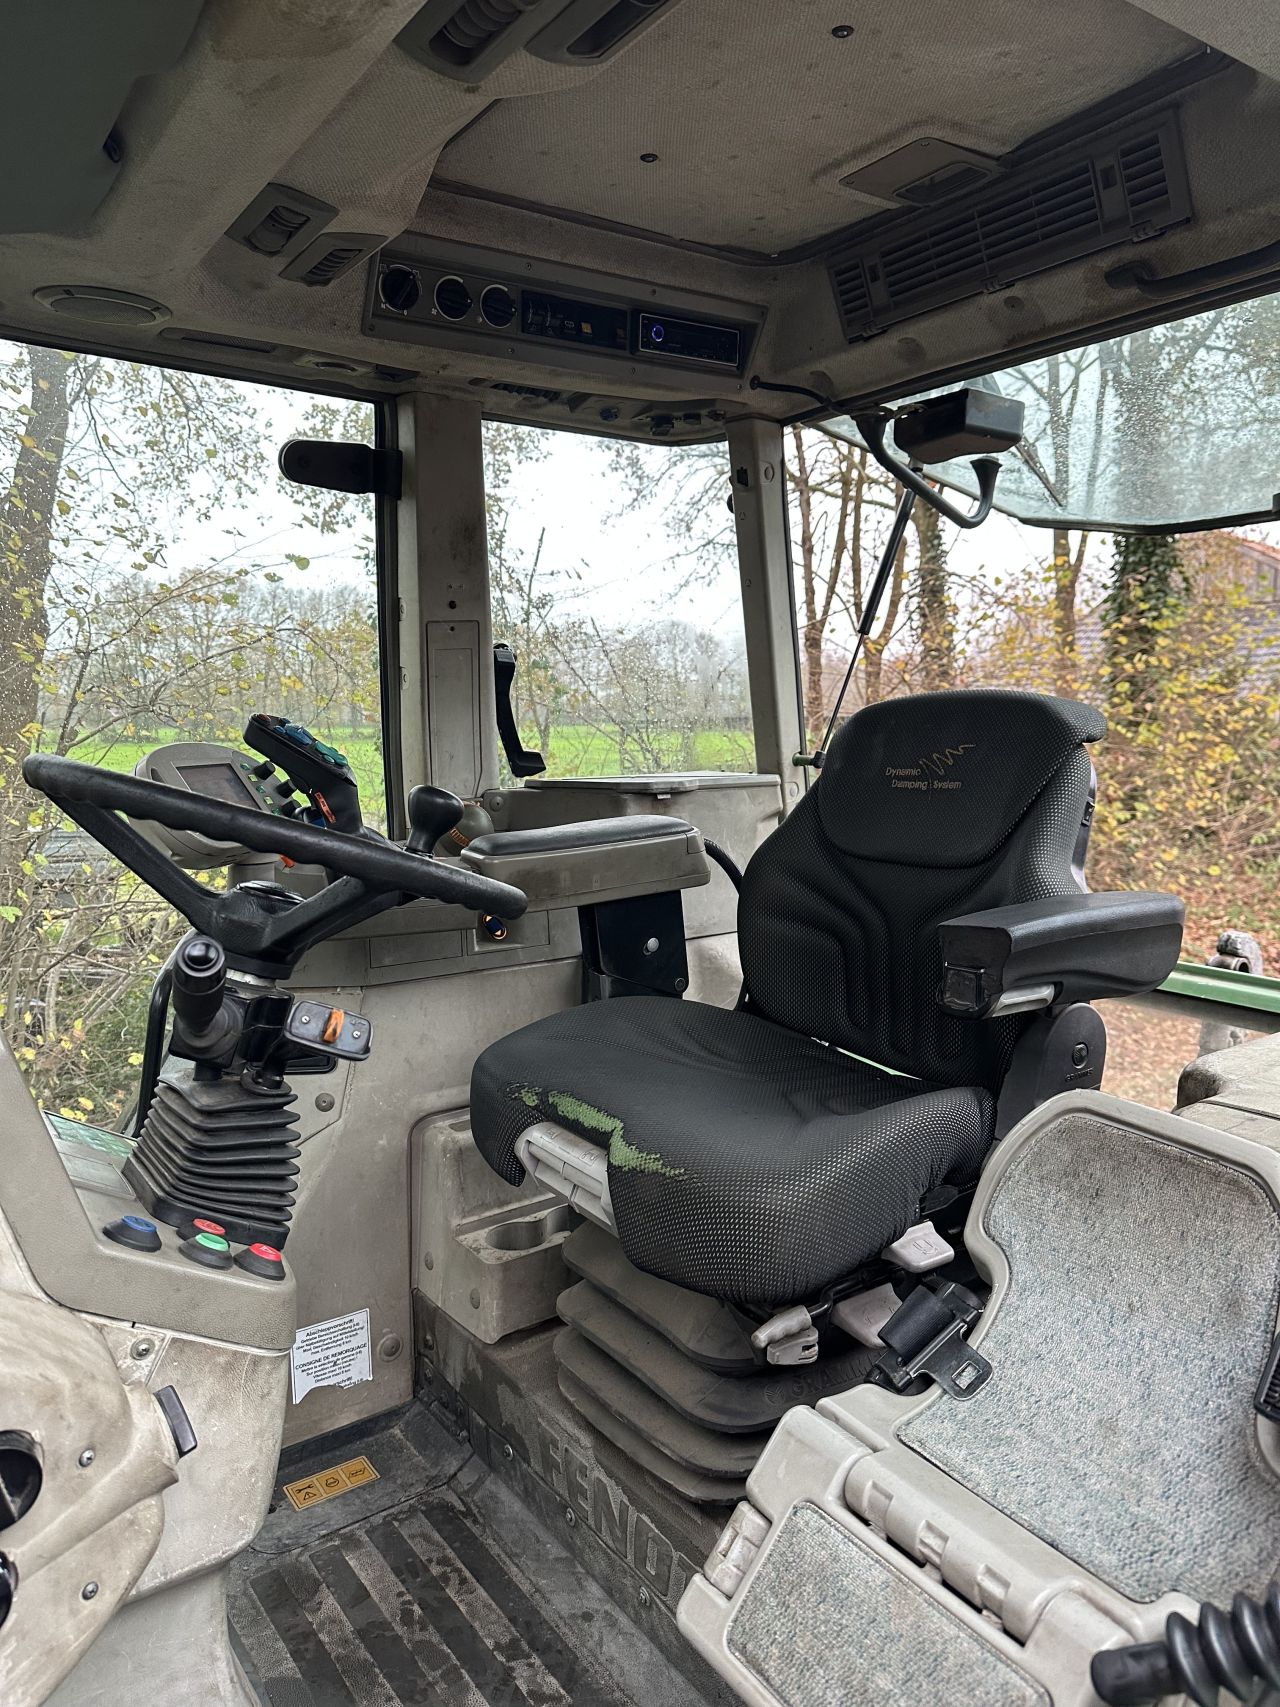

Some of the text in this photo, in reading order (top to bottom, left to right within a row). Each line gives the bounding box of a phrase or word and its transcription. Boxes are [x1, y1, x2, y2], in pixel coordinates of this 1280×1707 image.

[885, 767, 921, 778] Dynamic
[891, 779, 961, 790] Damping System
[295, 1357, 322, 1370] CONSIGNE
[331, 1342, 368, 1358] REMORQUAGE
[314, 1365, 329, 1374] position
[315, 1374, 332, 1383] Distance
